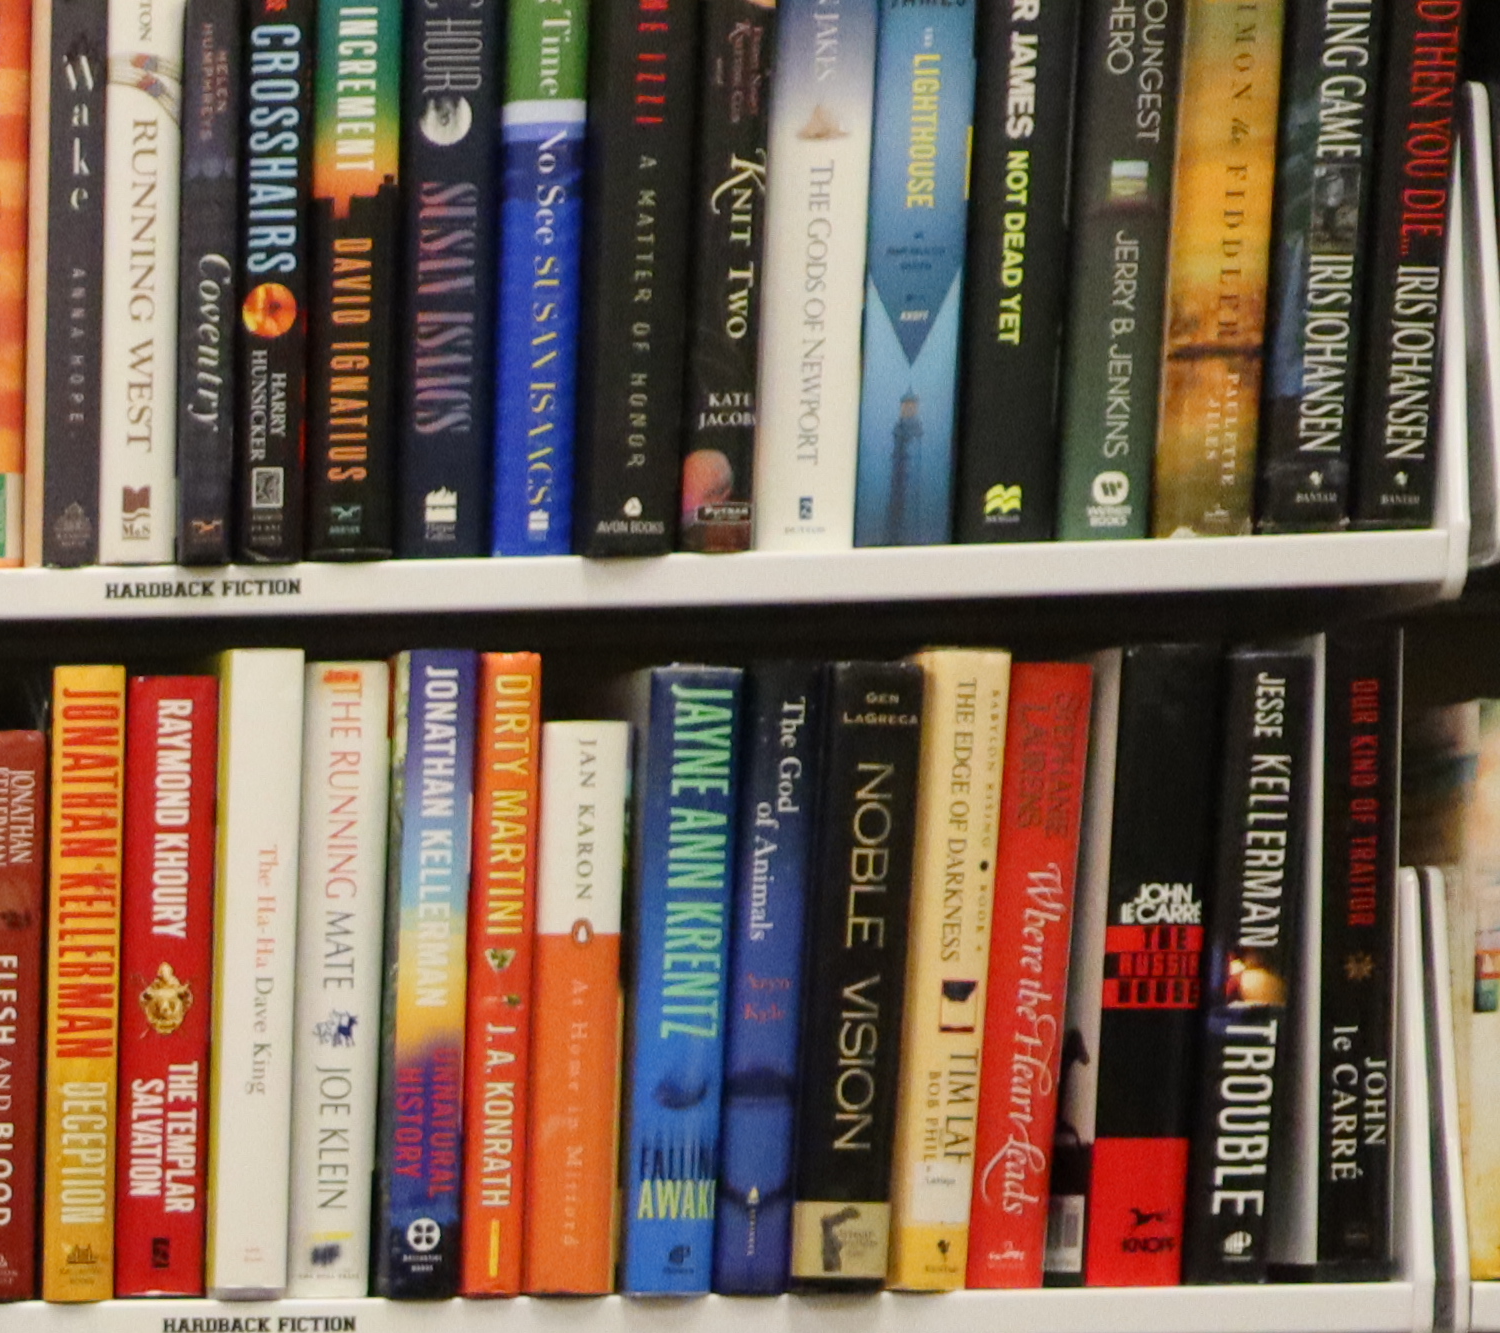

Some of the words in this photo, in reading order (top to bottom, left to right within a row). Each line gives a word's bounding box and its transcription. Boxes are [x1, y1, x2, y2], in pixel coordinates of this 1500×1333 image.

[1006, 30, 1038, 139] JAMES
[246, 24, 301, 274] CROSSHAIRS
[1002, 150, 1029, 204] NOT
[331, 238, 374, 328] DAVID
[1000, 209, 1026, 288] DEAD
[1307, 253, 1354, 317] IRIS
[998, 294, 1022, 344] YET
[328, 341, 372, 482] IGNATIUS
[1299, 313, 1352, 453] JOHANSEN
[105, 582, 215, 599] HARDBACK
[222, 581, 301, 596] FICTION
[154, 698, 194, 826] RAYMOND
[670, 684, 734, 799] JAYNE
[1254, 674, 1288, 739] JESSE
[150, 831, 190, 939] KHOURY
[666, 806, 728, 891] ANN
[842, 762, 895, 949] NOBLE
[1238, 754, 1292, 949] KELLERMAN
[660, 898, 726, 1040] KRENTZ
[486, 1024, 518, 1068] J.A.
[831, 976, 884, 1154] VISION
[479, 1074, 516, 1208] KONRATH
[1211, 1018, 1278, 1216] TROUBLE
